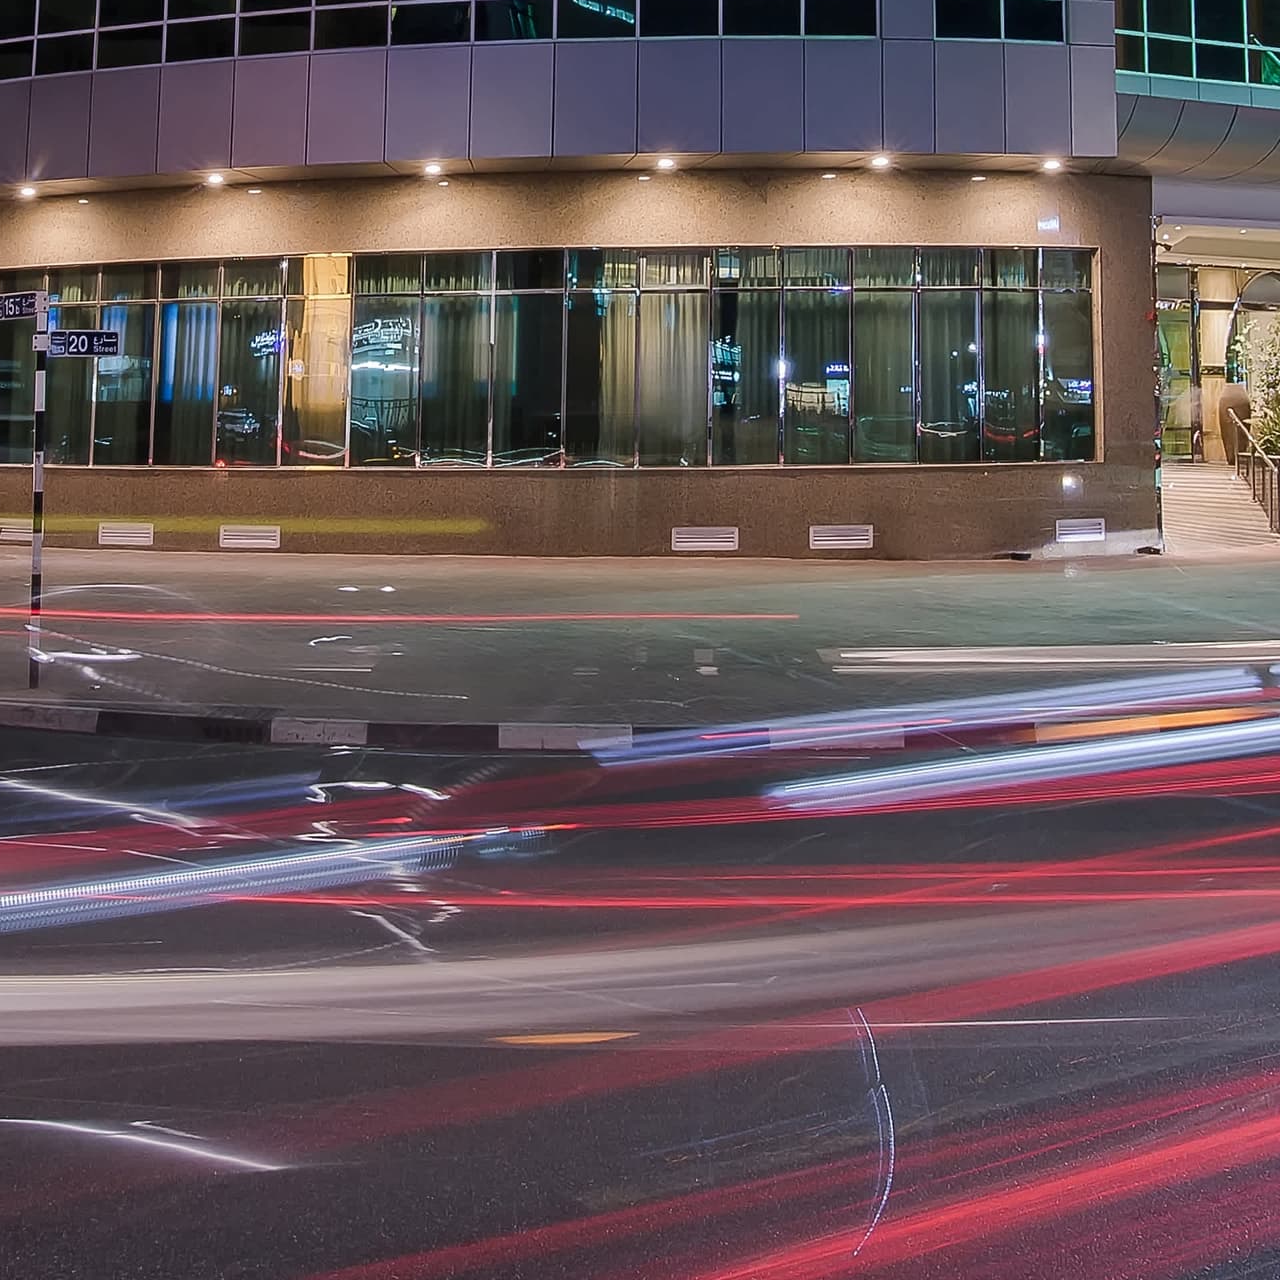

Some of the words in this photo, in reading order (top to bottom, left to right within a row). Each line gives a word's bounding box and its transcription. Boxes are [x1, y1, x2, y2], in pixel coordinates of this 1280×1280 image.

[69, 335, 88, 352] 20
[93, 334, 117, 345] شارع
[93, 345, 117, 353] Street
